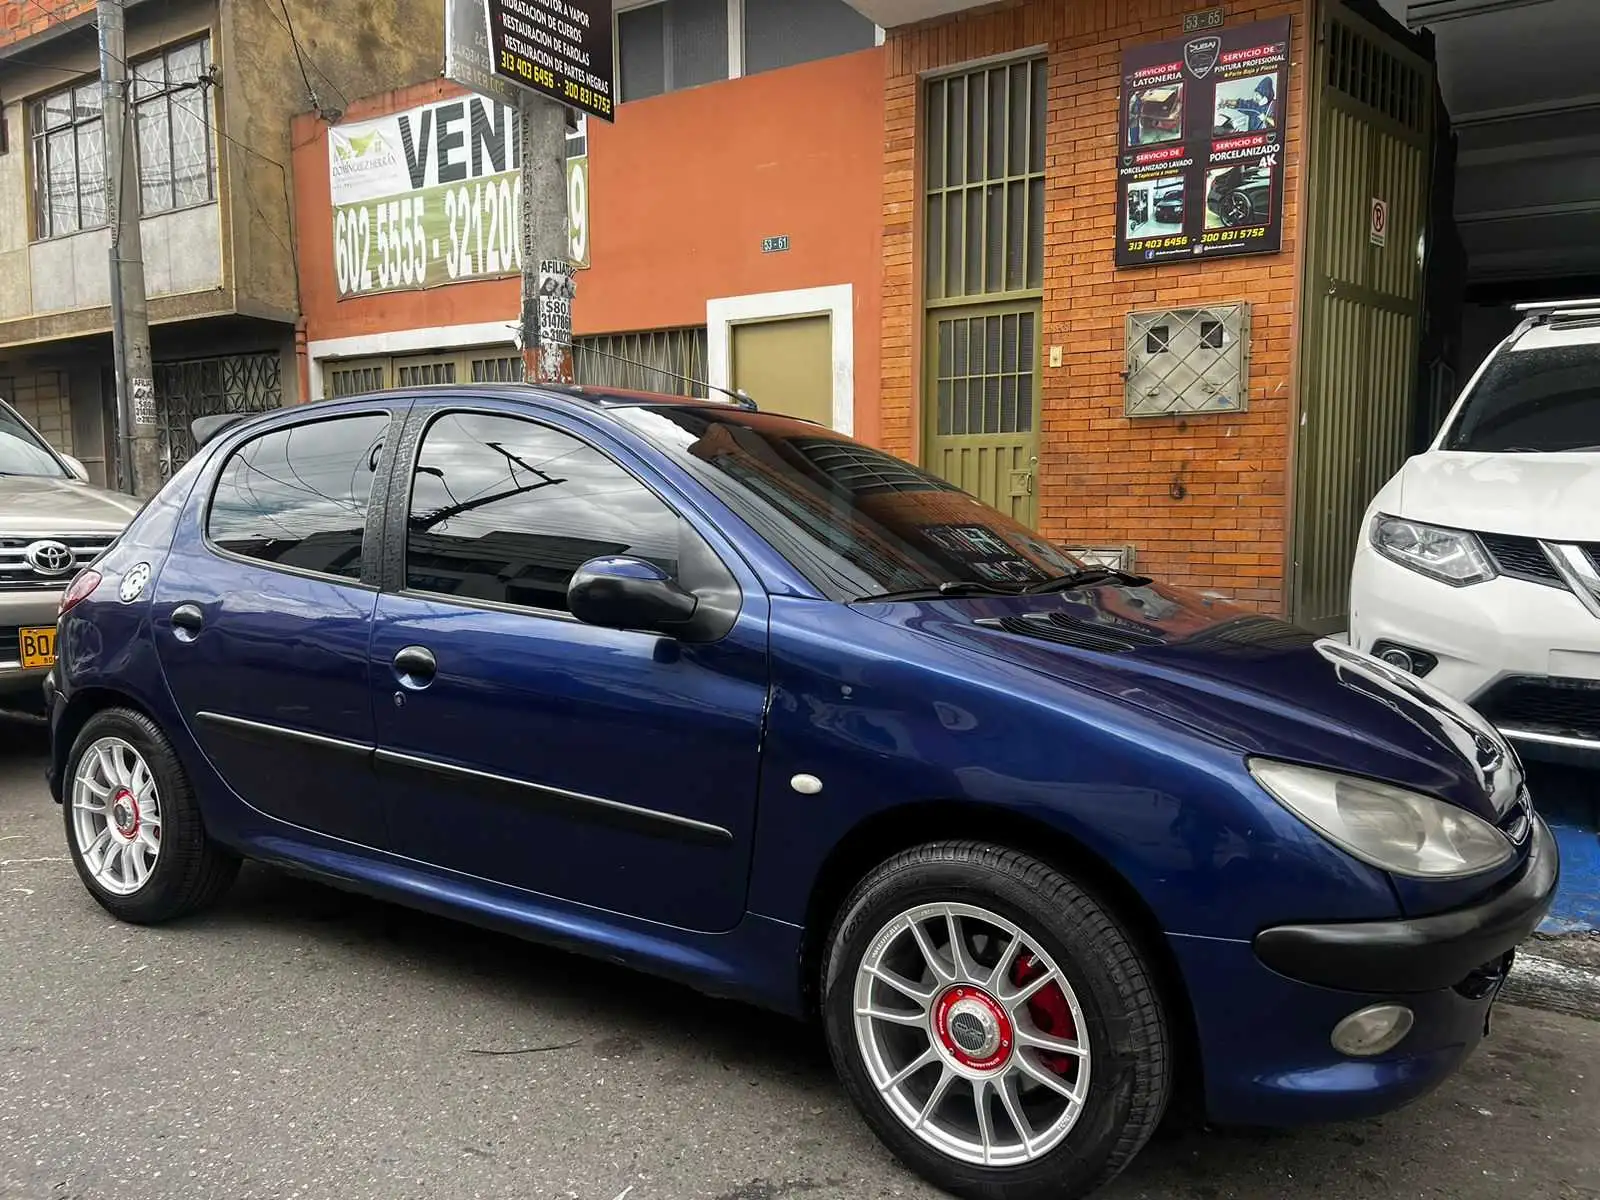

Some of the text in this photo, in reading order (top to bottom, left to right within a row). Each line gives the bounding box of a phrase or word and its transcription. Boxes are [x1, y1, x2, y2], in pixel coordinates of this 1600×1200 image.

[563, 3, 569, 18] A
[547, 14, 557, 31] DE
[557, 20, 582, 43] CUEROS
[502, 12, 553, 48] RESTAURACION
[553, 37, 562, 53] DE
[563, 42, 590, 67] FAROLAS
[1223, 46, 1275, 62] SERVICIO DE
[504, 34, 554, 69] RESTAURACION
[554, 57, 563, 73] DE
[563, 62, 585, 83] PARTES
[586, 73, 609, 94] NEGRAS
[1134, 66, 1166, 78] SERVICIO
[1214, 62, 1241, 73] PINTURA
[1242, 54, 1285, 68] PROFESIONAL
[500, 50, 514, 71] 313
[516, 58, 532, 79] 403
[533, 66, 554, 89] 6456
[564, 79, 578, 99] 300
[580, 86, 592, 105] 831
[593, 92, 611, 114] 5752
[1133, 72, 1182, 87] LATONERIA
[1216, 136, 1263, 150] SERVICIO DE
[1136, 151, 1169, 162] SERVICIO
[1209, 144, 1280, 162] PORCELANIZADO
[1259, 153, 1277, 168] 4K
[1120, 158, 1193, 175] PORCELANIZADO LAVADO
[335, 206, 372, 295] 602
[377, 196, 427, 289] 5555
[1128, 242, 1143, 251] 313
[1145, 239, 1161, 248] 403
[1200, 233, 1219, 243] 300
[1221, 231, 1237, 241] 831
[1240, 228, 1264, 238] 5752
